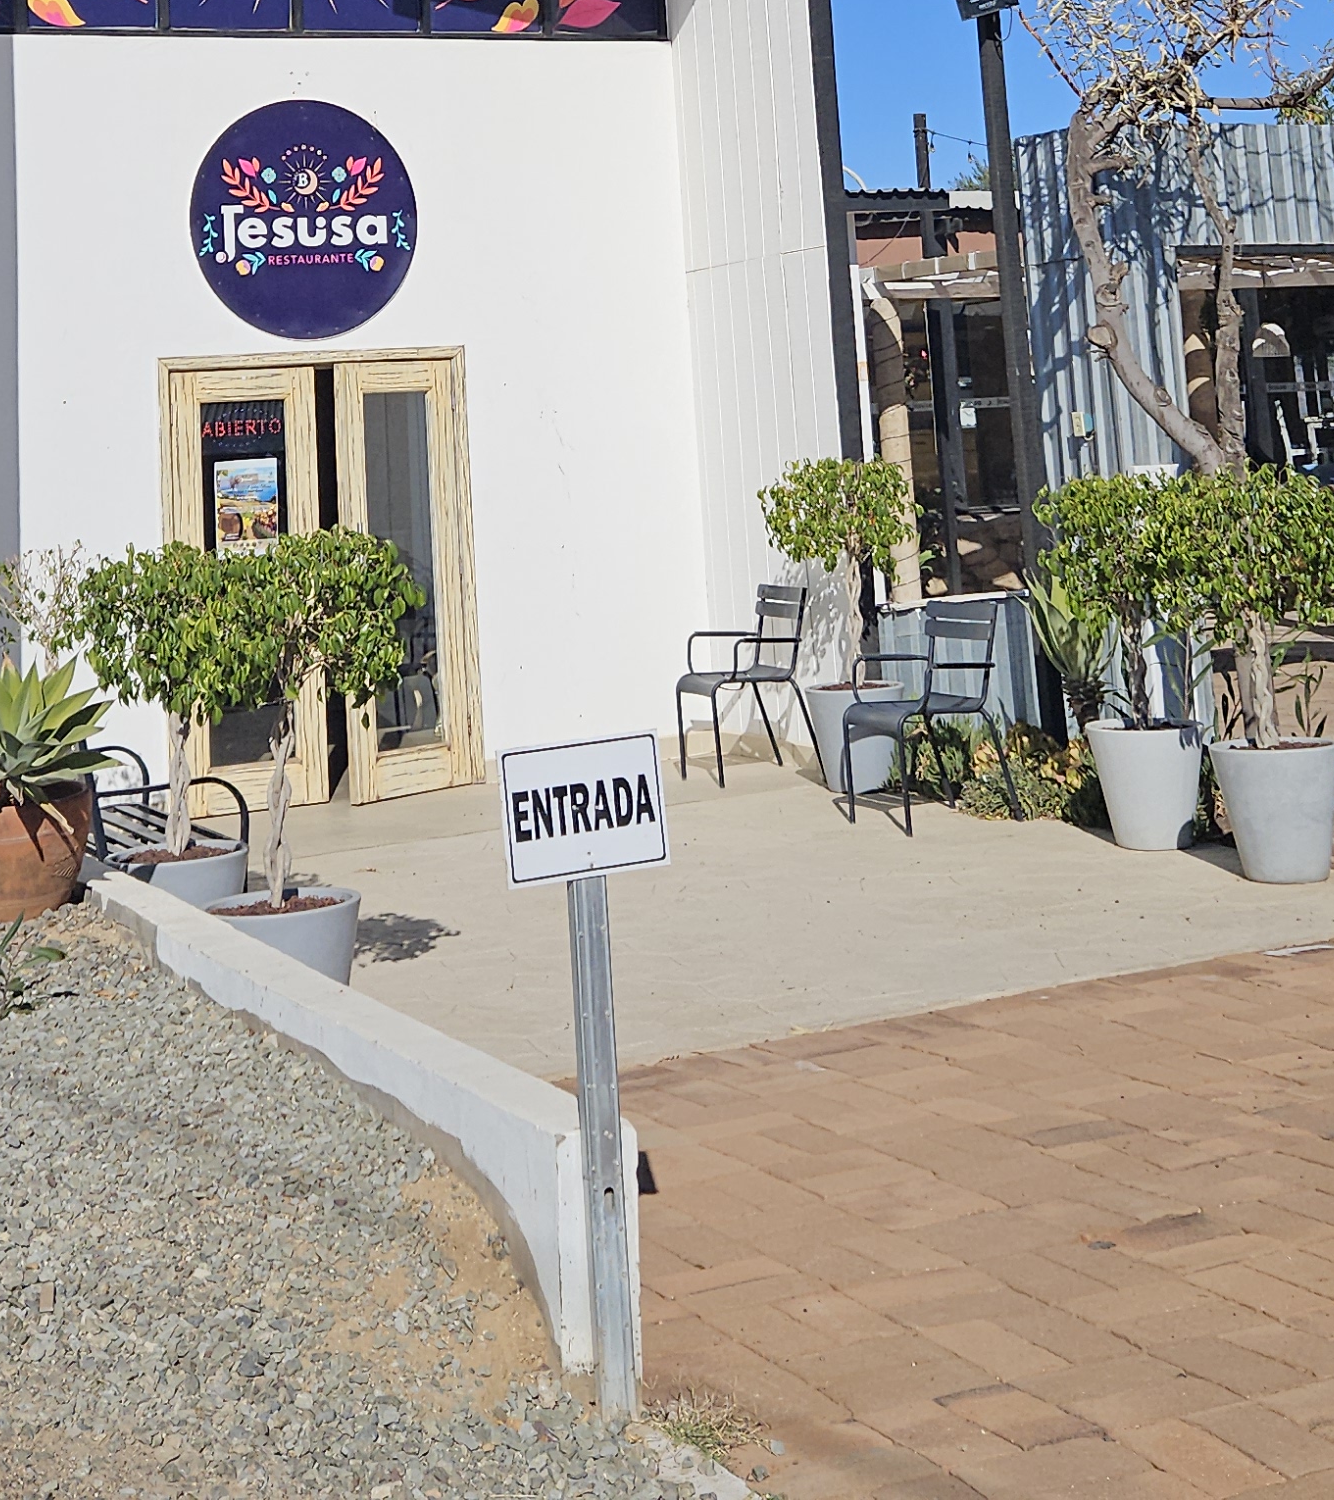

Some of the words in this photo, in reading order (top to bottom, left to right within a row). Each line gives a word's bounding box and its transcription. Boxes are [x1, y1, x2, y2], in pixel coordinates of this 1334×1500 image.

[293, 172, 309, 188] B
[216, 204, 389, 263] Jesusa
[267, 252, 354, 266] RESTAURANTE
[201, 417, 281, 437] ABIERTO
[511, 773, 656, 844] ENTRADA
